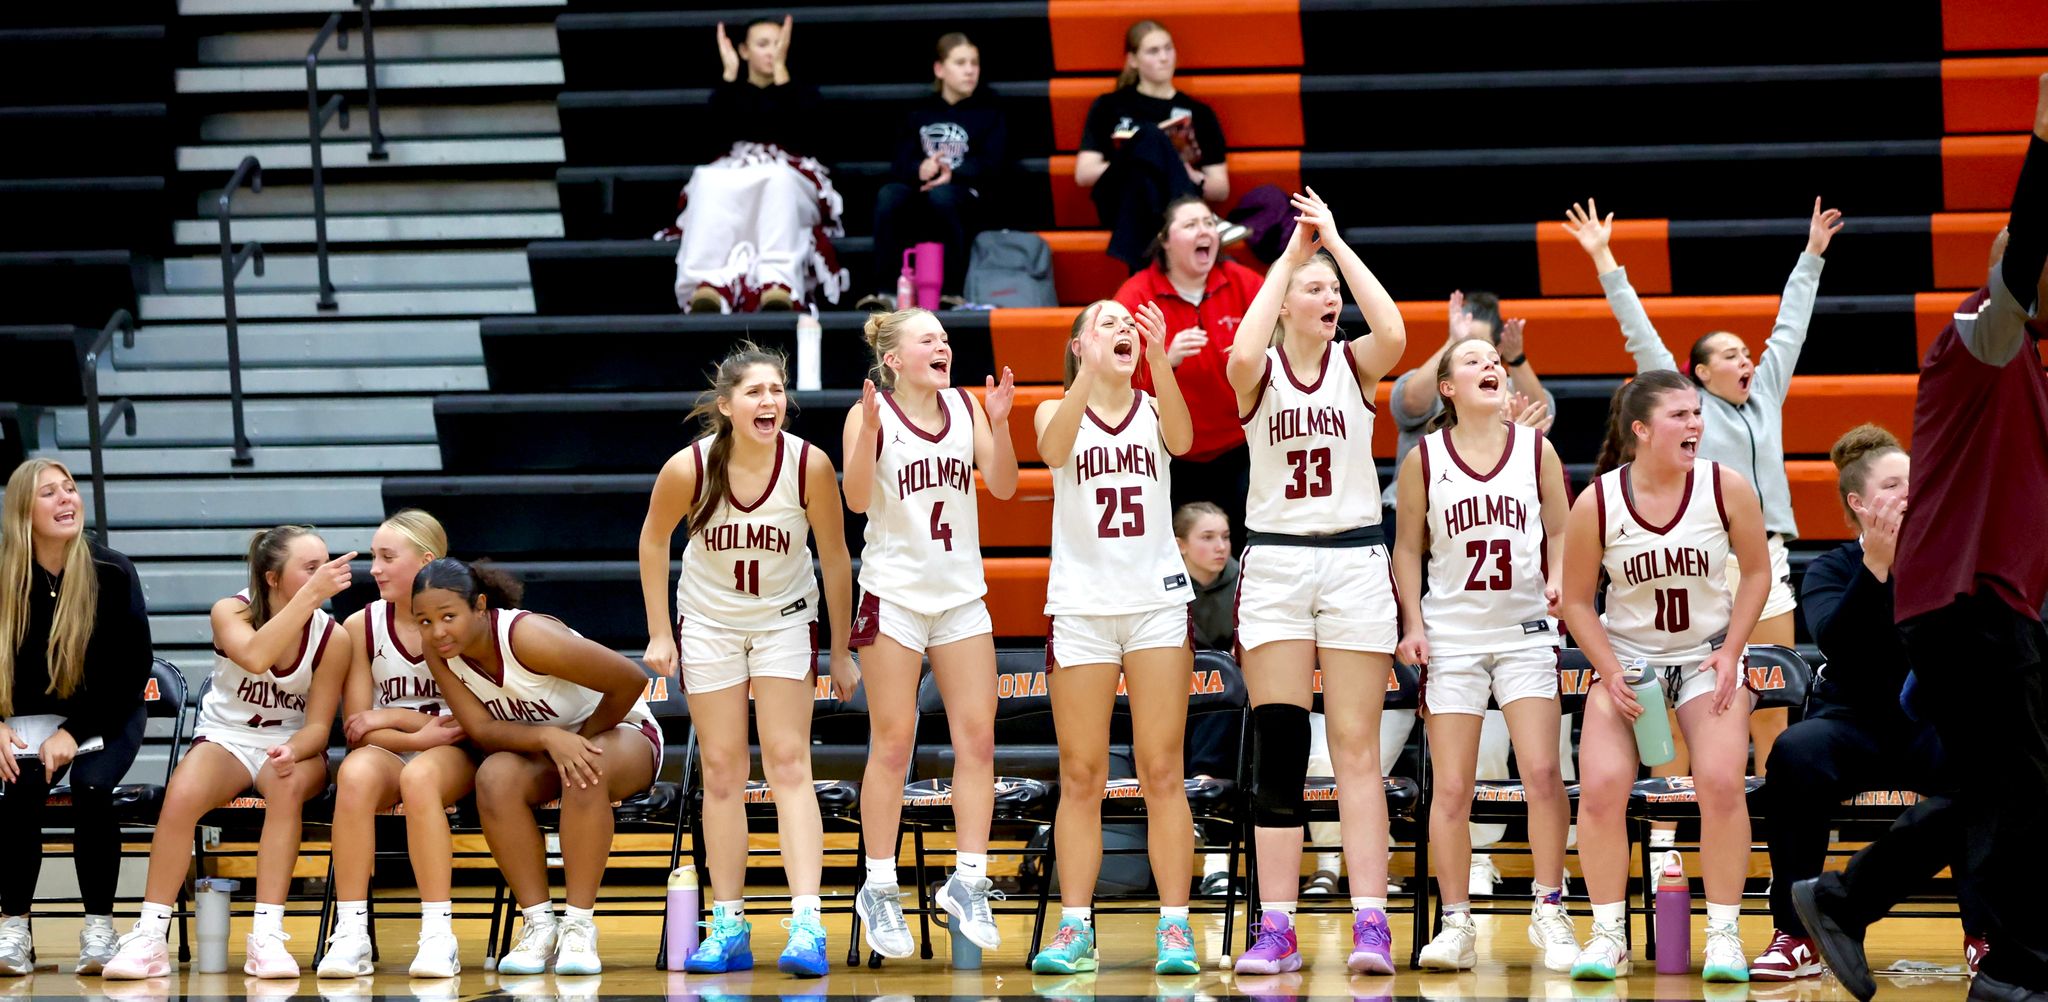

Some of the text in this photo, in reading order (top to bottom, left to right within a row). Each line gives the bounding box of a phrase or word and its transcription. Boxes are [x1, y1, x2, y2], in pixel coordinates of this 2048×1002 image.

[1269, 406, 1346, 446] HOLMEN
[898, 456, 971, 500] HOLMEN
[1076, 444, 1158, 485] HOLMEN
[1285, 447, 1332, 499] 33
[930, 501, 952, 551] 4
[1096, 486, 1145, 538] 25
[1445, 495, 1527, 538] HOLMEN
[704, 523, 790, 555] HOLMEN
[733, 560, 759, 597] 11
[1464, 539, 1512, 591] 23
[1623, 547, 1709, 586] HOLMEN
[1655, 588, 1690, 633] 10
[237, 677, 306, 713] HOLMEN
[380, 676, 441, 705] HOLM
[996, 671, 1048, 699] ONA
[485, 697, 560, 721] OLMEN
